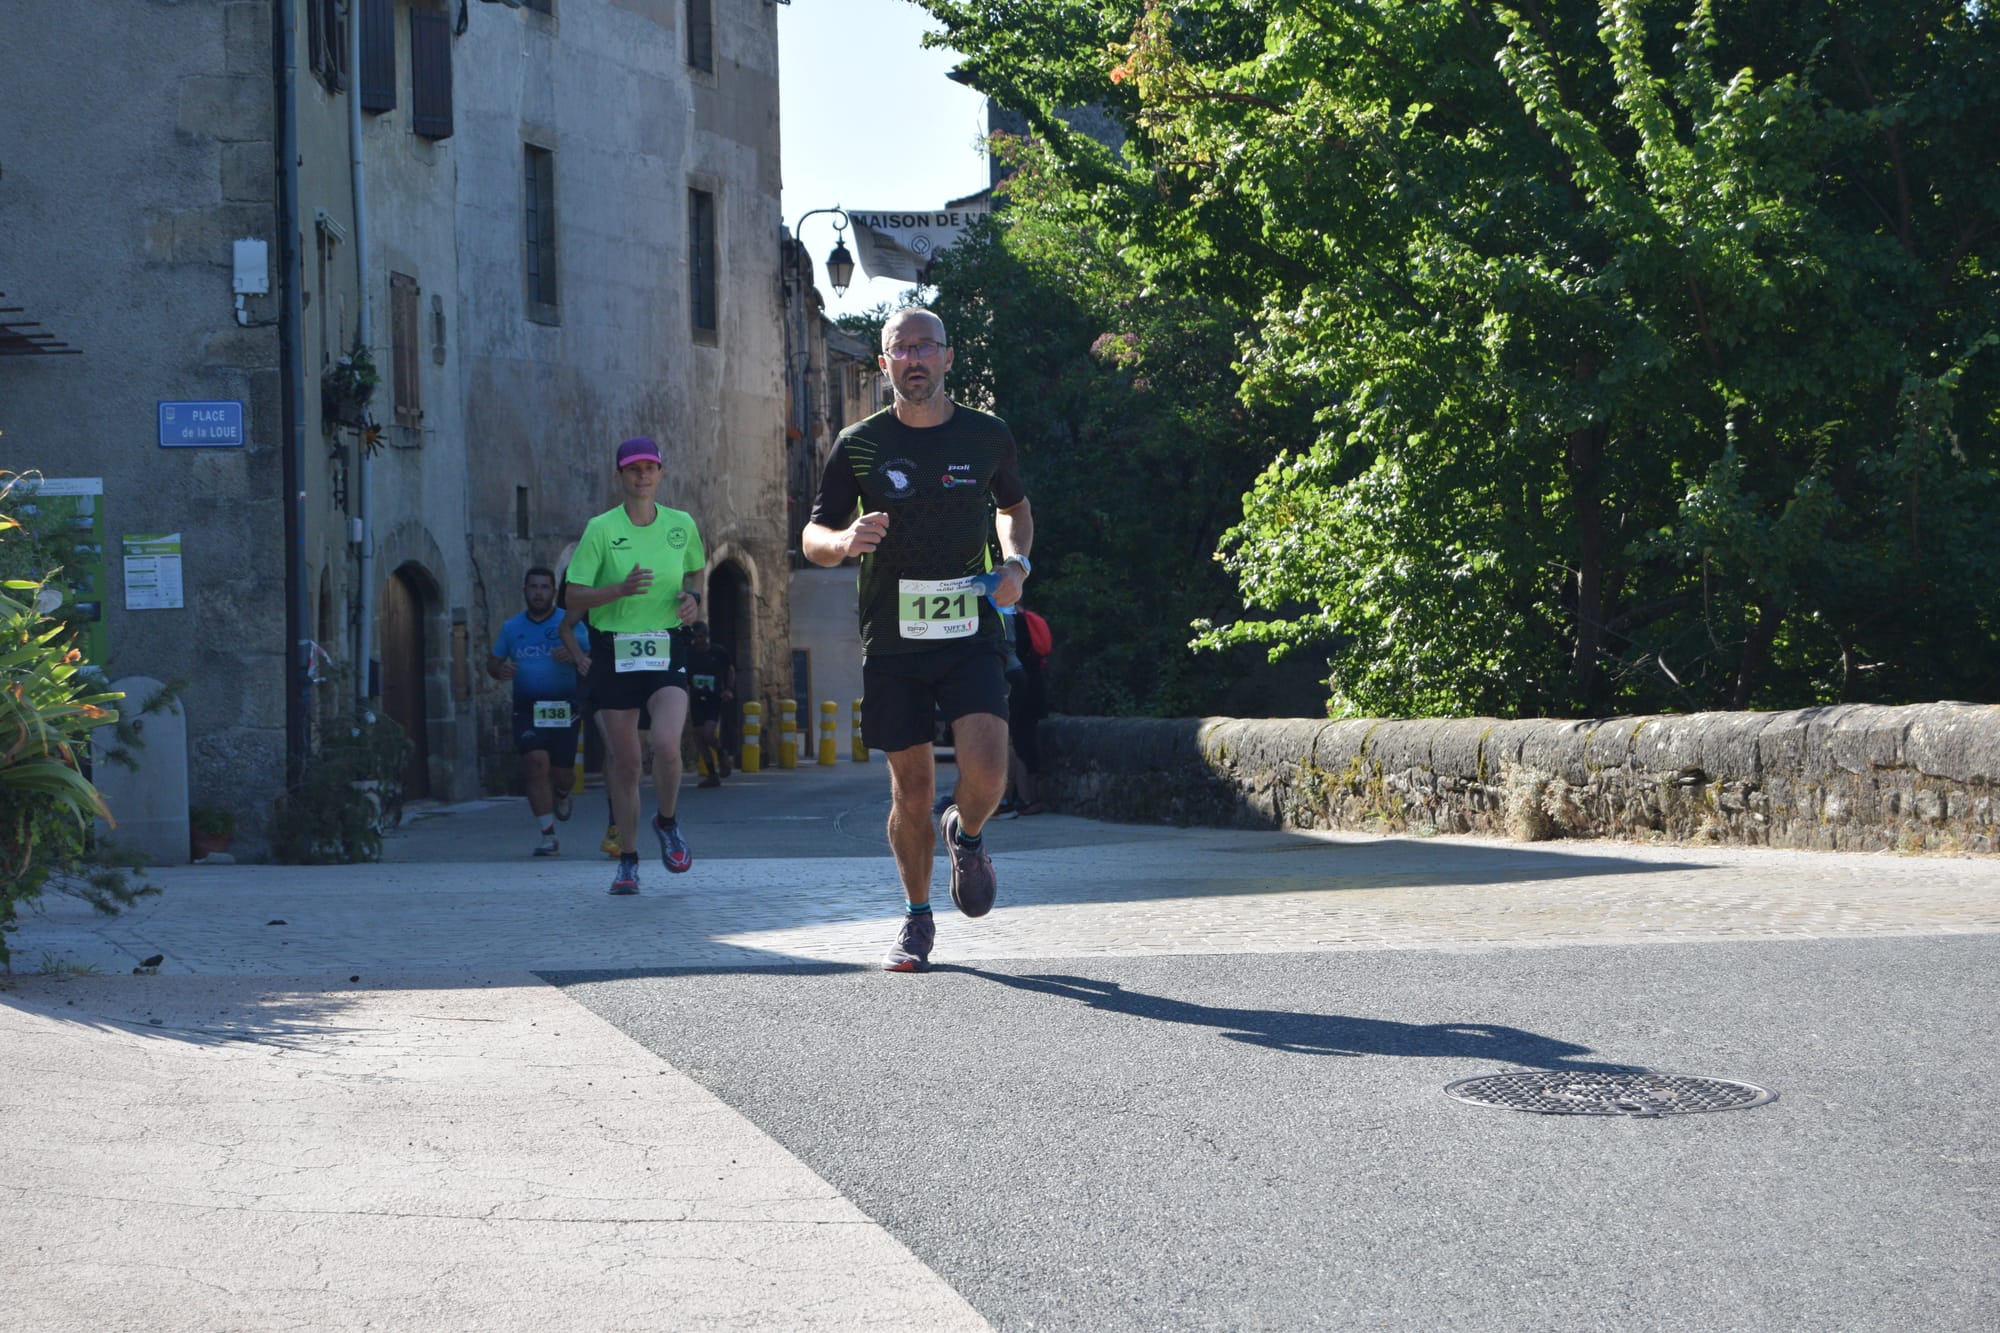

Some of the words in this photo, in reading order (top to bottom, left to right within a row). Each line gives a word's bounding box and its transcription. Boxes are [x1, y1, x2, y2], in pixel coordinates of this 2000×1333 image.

[852, 214, 929, 228] MAISON
[936, 213, 959, 226] DE
[192, 410, 225, 421] PLACE
[182, 427, 193, 438] de
[197, 427, 207, 438] la
[210, 426, 237, 438] LOUE
[912, 594, 966, 619] 121
[630, 640, 656, 657] 36
[539, 708, 566, 719] 138
